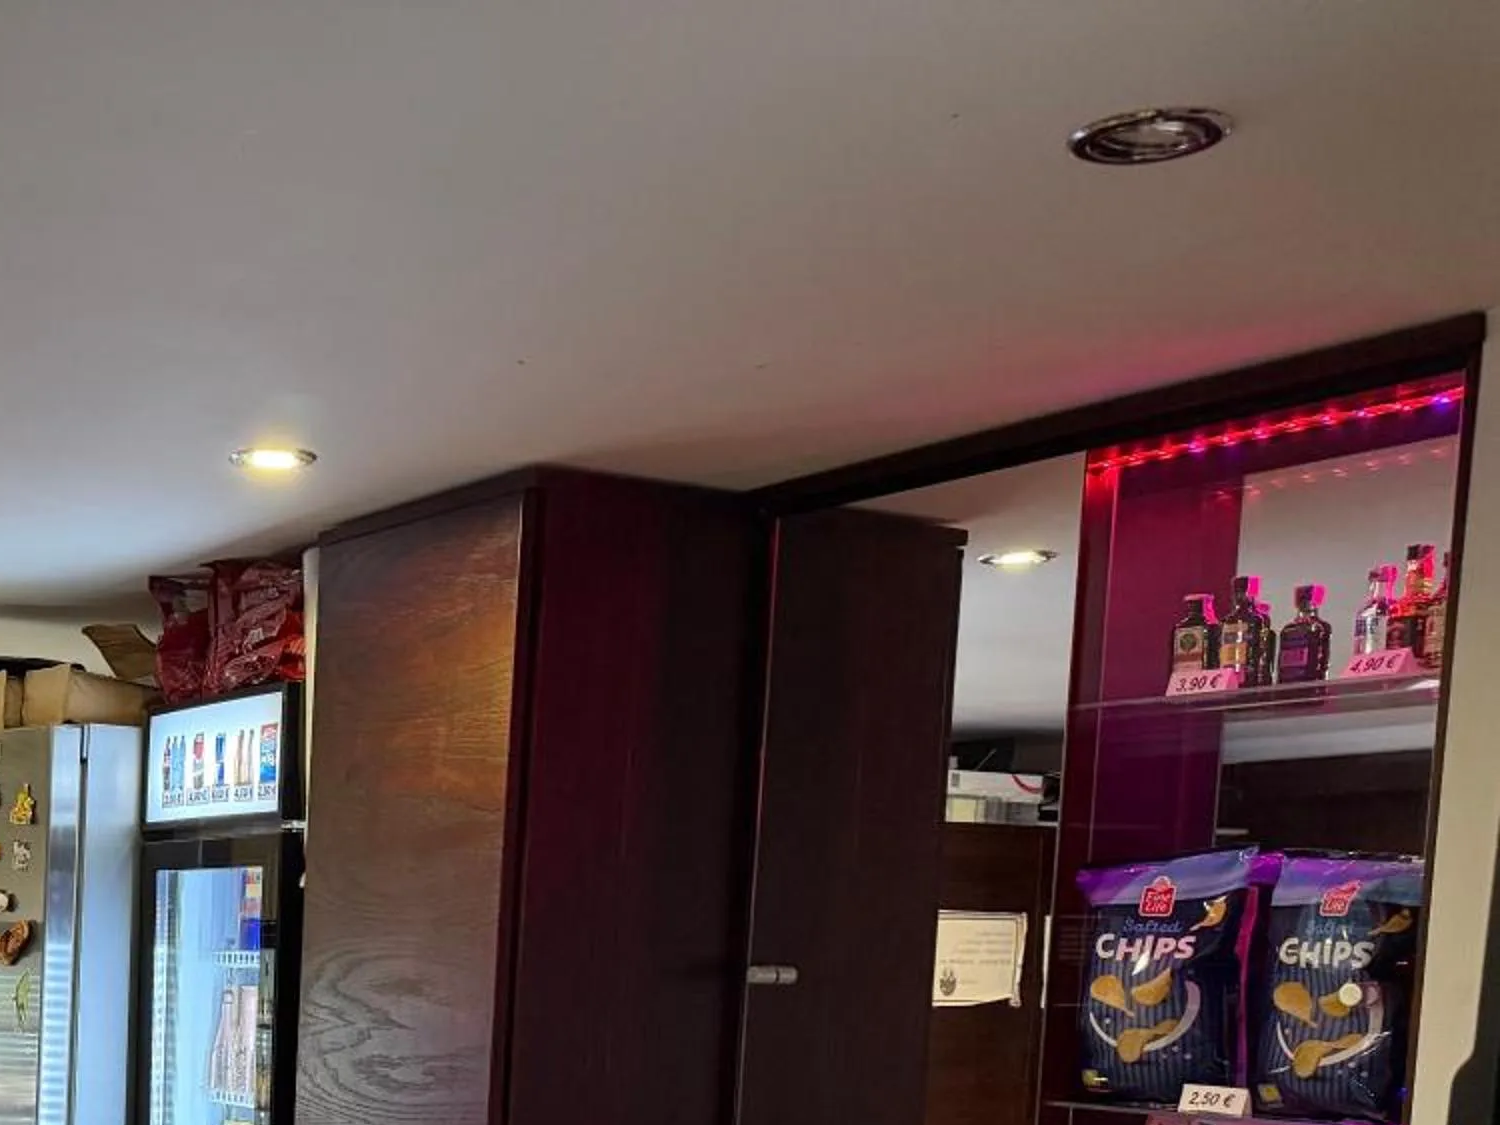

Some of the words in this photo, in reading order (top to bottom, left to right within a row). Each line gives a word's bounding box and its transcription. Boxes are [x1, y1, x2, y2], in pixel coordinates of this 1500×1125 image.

[1096, 933, 1196, 960] CHIPS
[1279, 937, 1376, 969] CHIPS
[1188, 1091, 1220, 1107] 2,50
[1223, 1093, 1237, 1109] €
